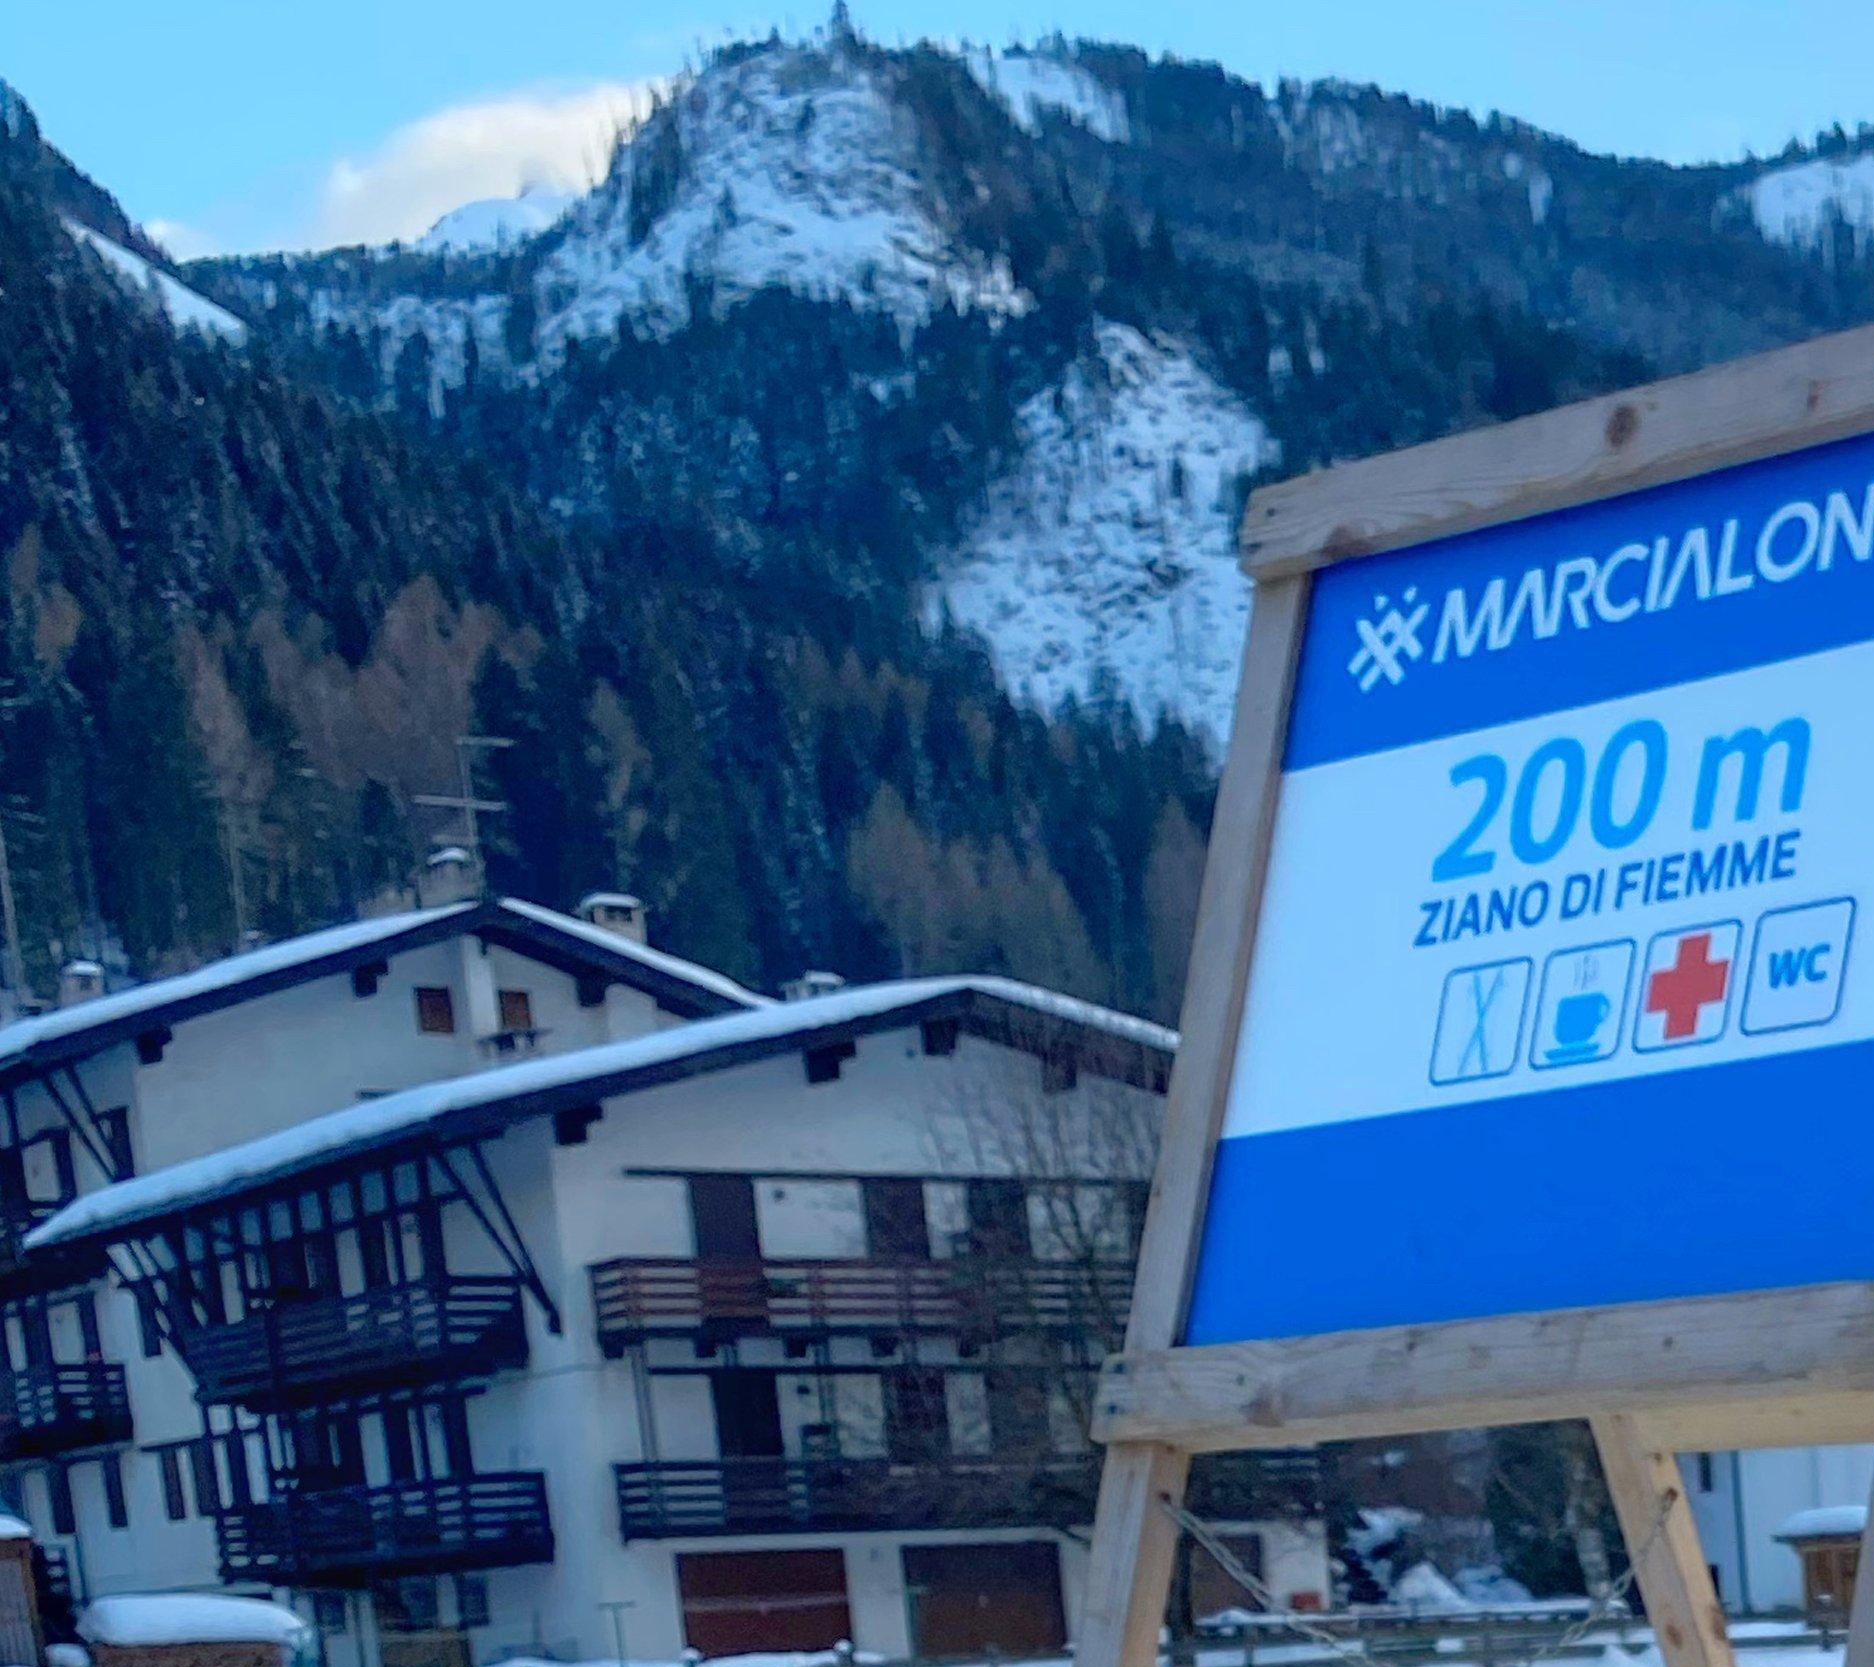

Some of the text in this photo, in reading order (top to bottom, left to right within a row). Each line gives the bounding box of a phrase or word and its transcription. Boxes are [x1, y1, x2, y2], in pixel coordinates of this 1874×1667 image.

[1431, 716, 1812, 884] 200 m
[1413, 831, 1803, 948] ZIANO DI FIEMME
[1767, 941, 1831, 990] WC
